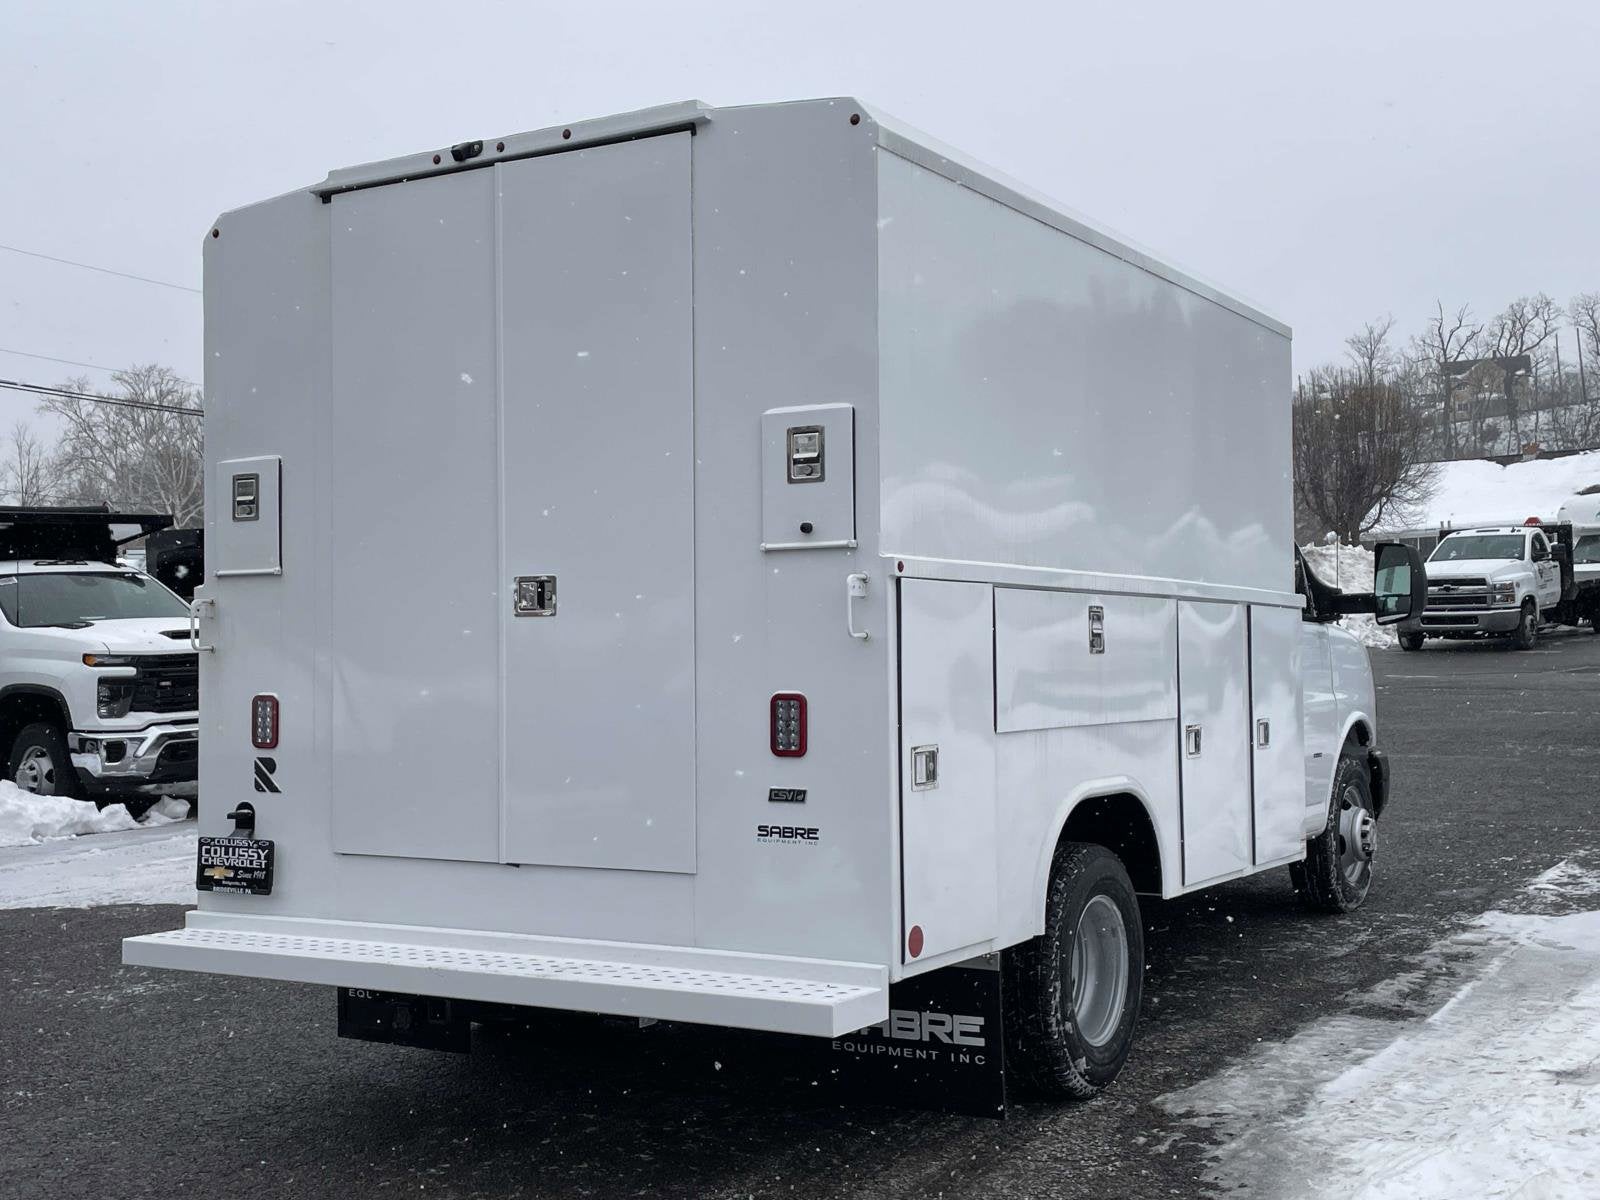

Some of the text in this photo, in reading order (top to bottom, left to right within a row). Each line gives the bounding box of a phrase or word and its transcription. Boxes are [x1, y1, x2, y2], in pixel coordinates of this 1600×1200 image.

[757, 824, 819, 840] SABRE
[215, 838, 255, 847] COLUSSY
[201, 845, 269, 860] COLUSSY
[201, 856, 267, 868] CHEVROLET
[852, 1009, 985, 1047] BRE
[832, 1041, 986, 1065] EQUIPMENT INC
